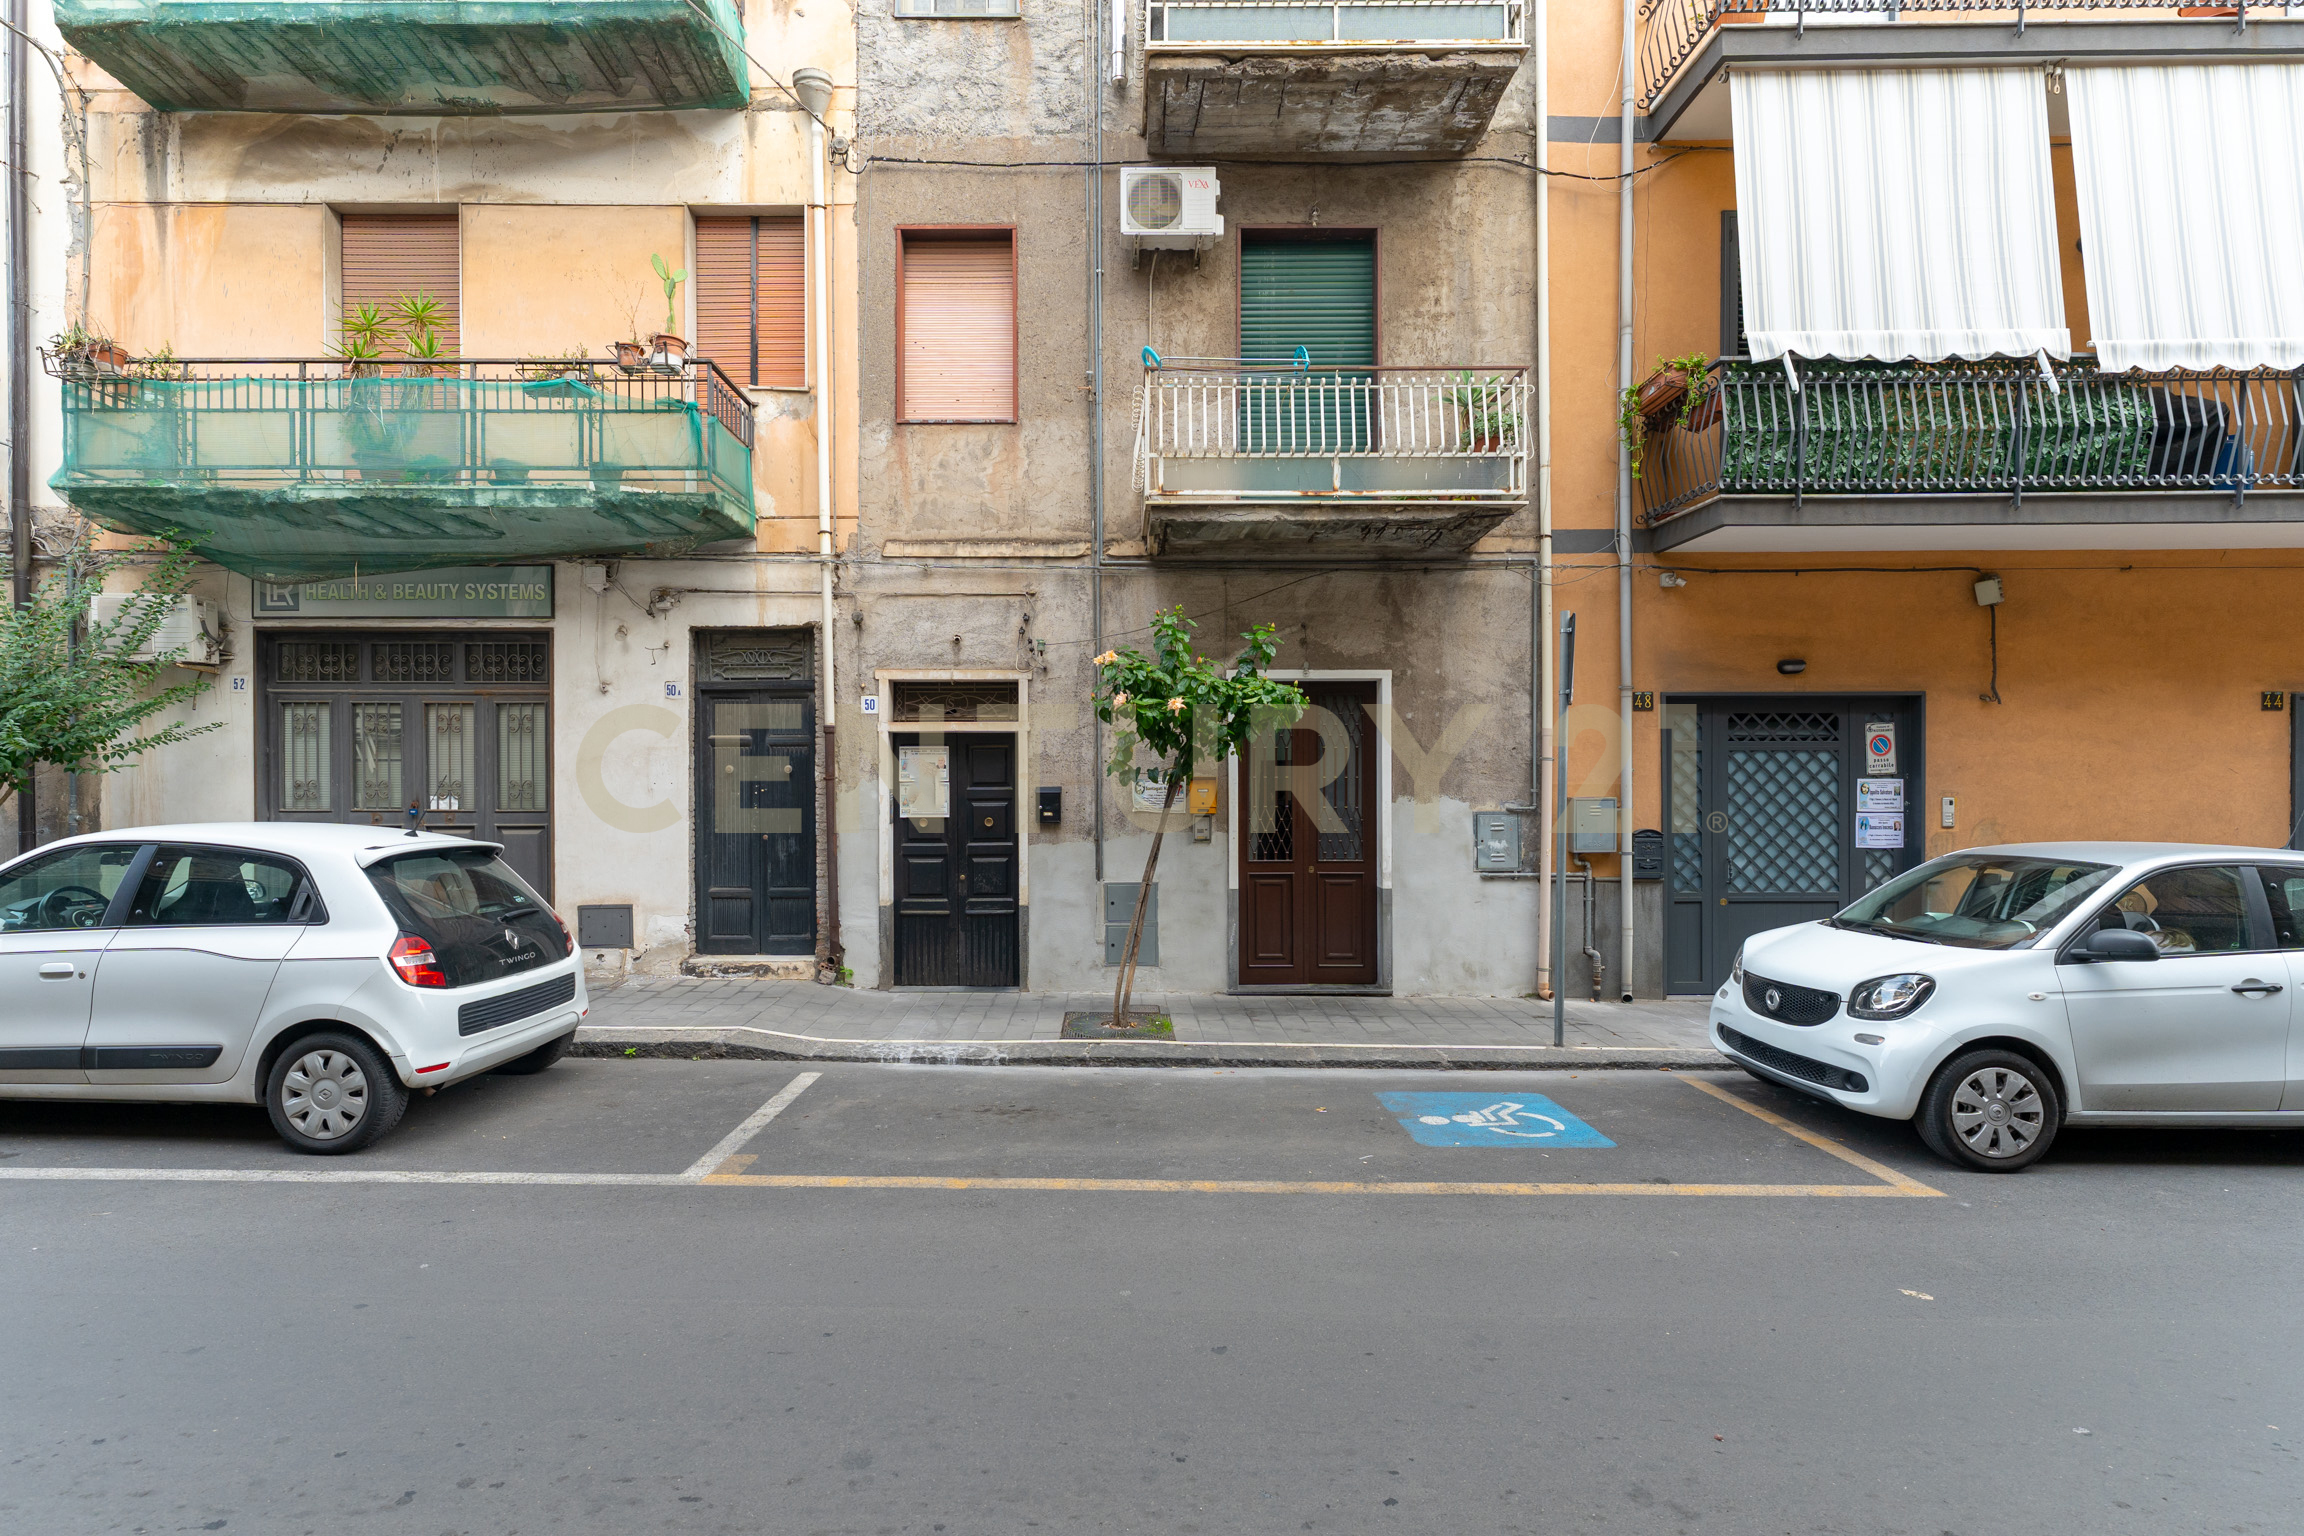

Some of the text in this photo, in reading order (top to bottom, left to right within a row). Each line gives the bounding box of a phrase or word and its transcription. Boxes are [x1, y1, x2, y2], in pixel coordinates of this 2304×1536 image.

[305, 583, 546, 601] HEALTH & BEAUTY SYSTEMS
[233, 678, 245, 690] 52
[864, 698, 875, 711] 50
[1634, 694, 1652, 709] 48
[2263, 694, 2282, 708] 44
[499, 951, 536, 966] TWINGO
